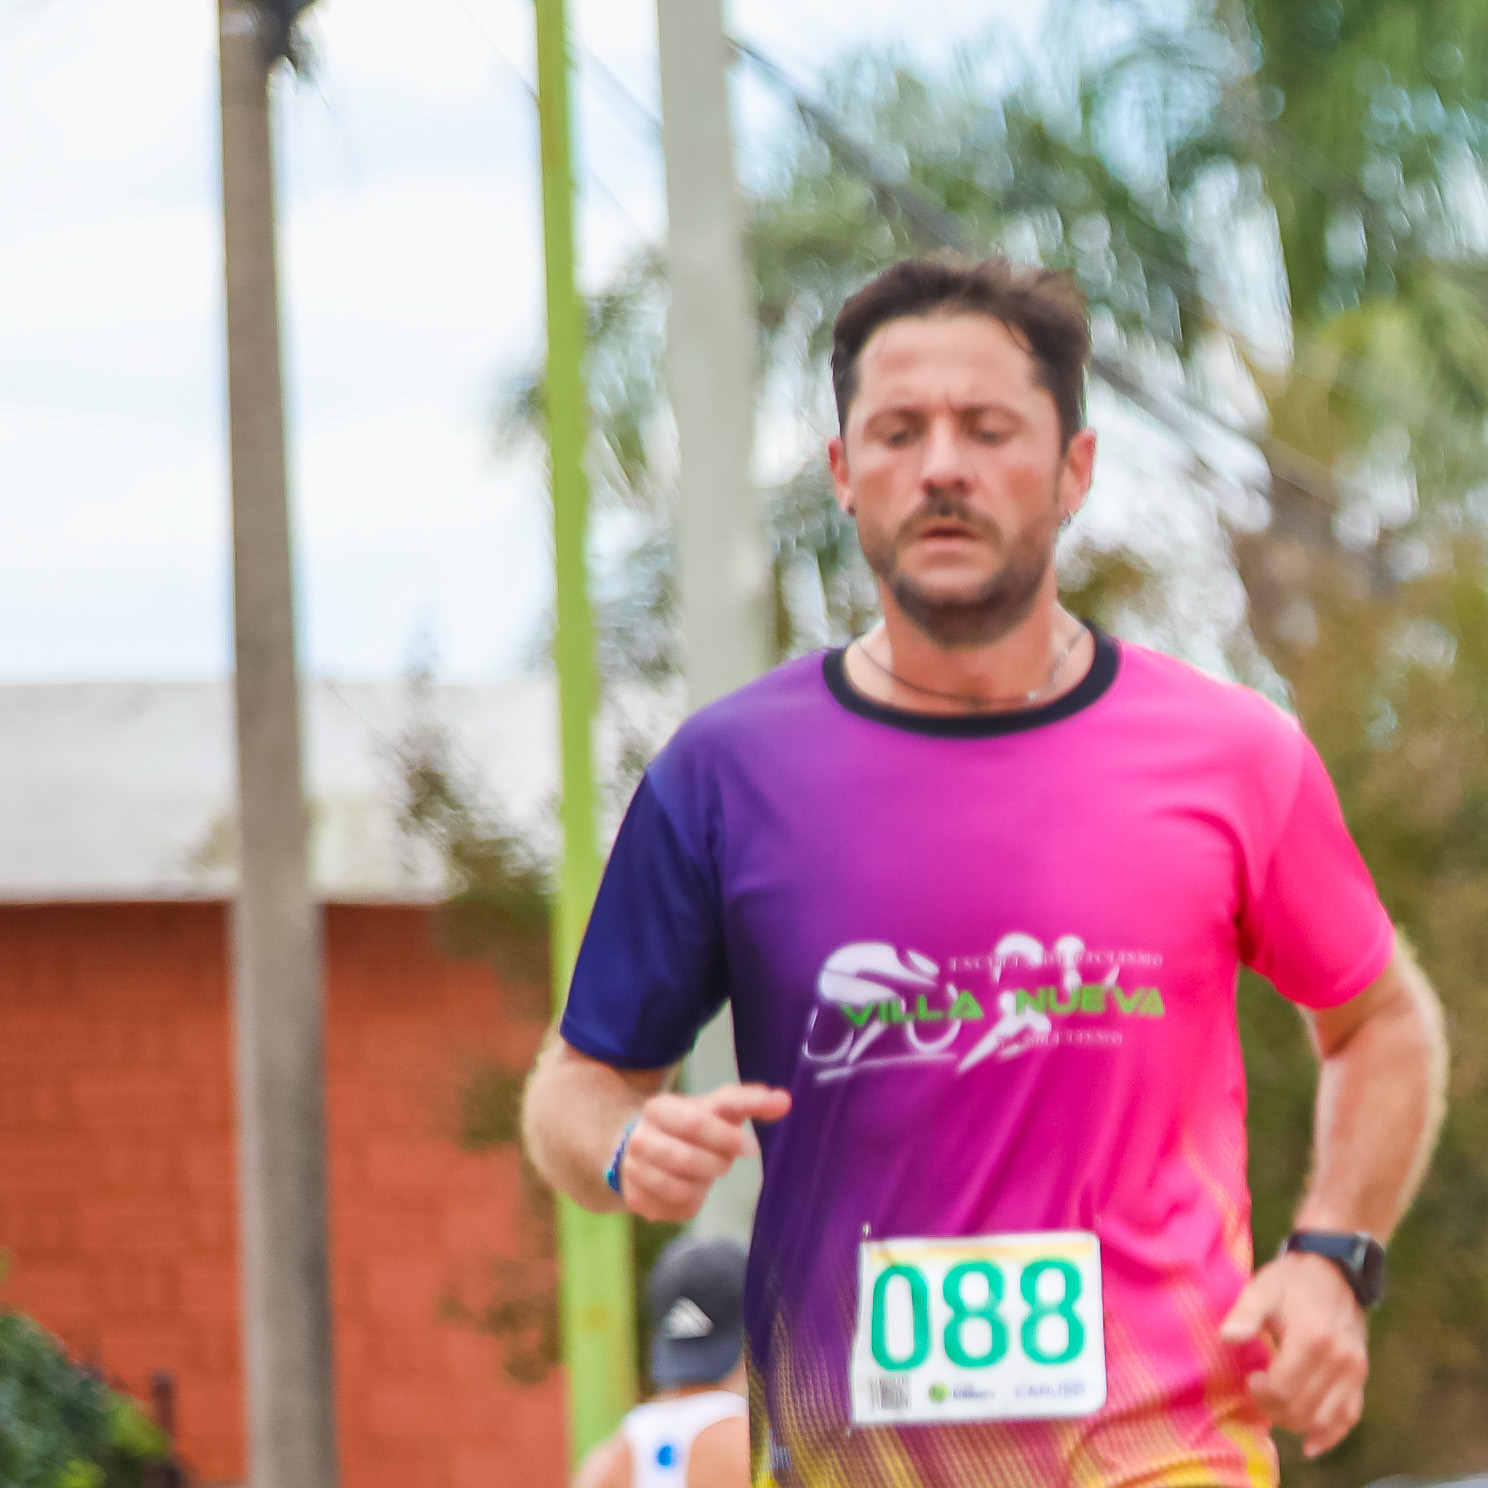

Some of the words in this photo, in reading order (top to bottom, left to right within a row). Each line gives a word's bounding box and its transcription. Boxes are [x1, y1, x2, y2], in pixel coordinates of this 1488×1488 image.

[841, 990, 984, 1026] VILLA
[1016, 984, 1164, 1017] NUEVA
[871, 1257, 1085, 1371] 088
